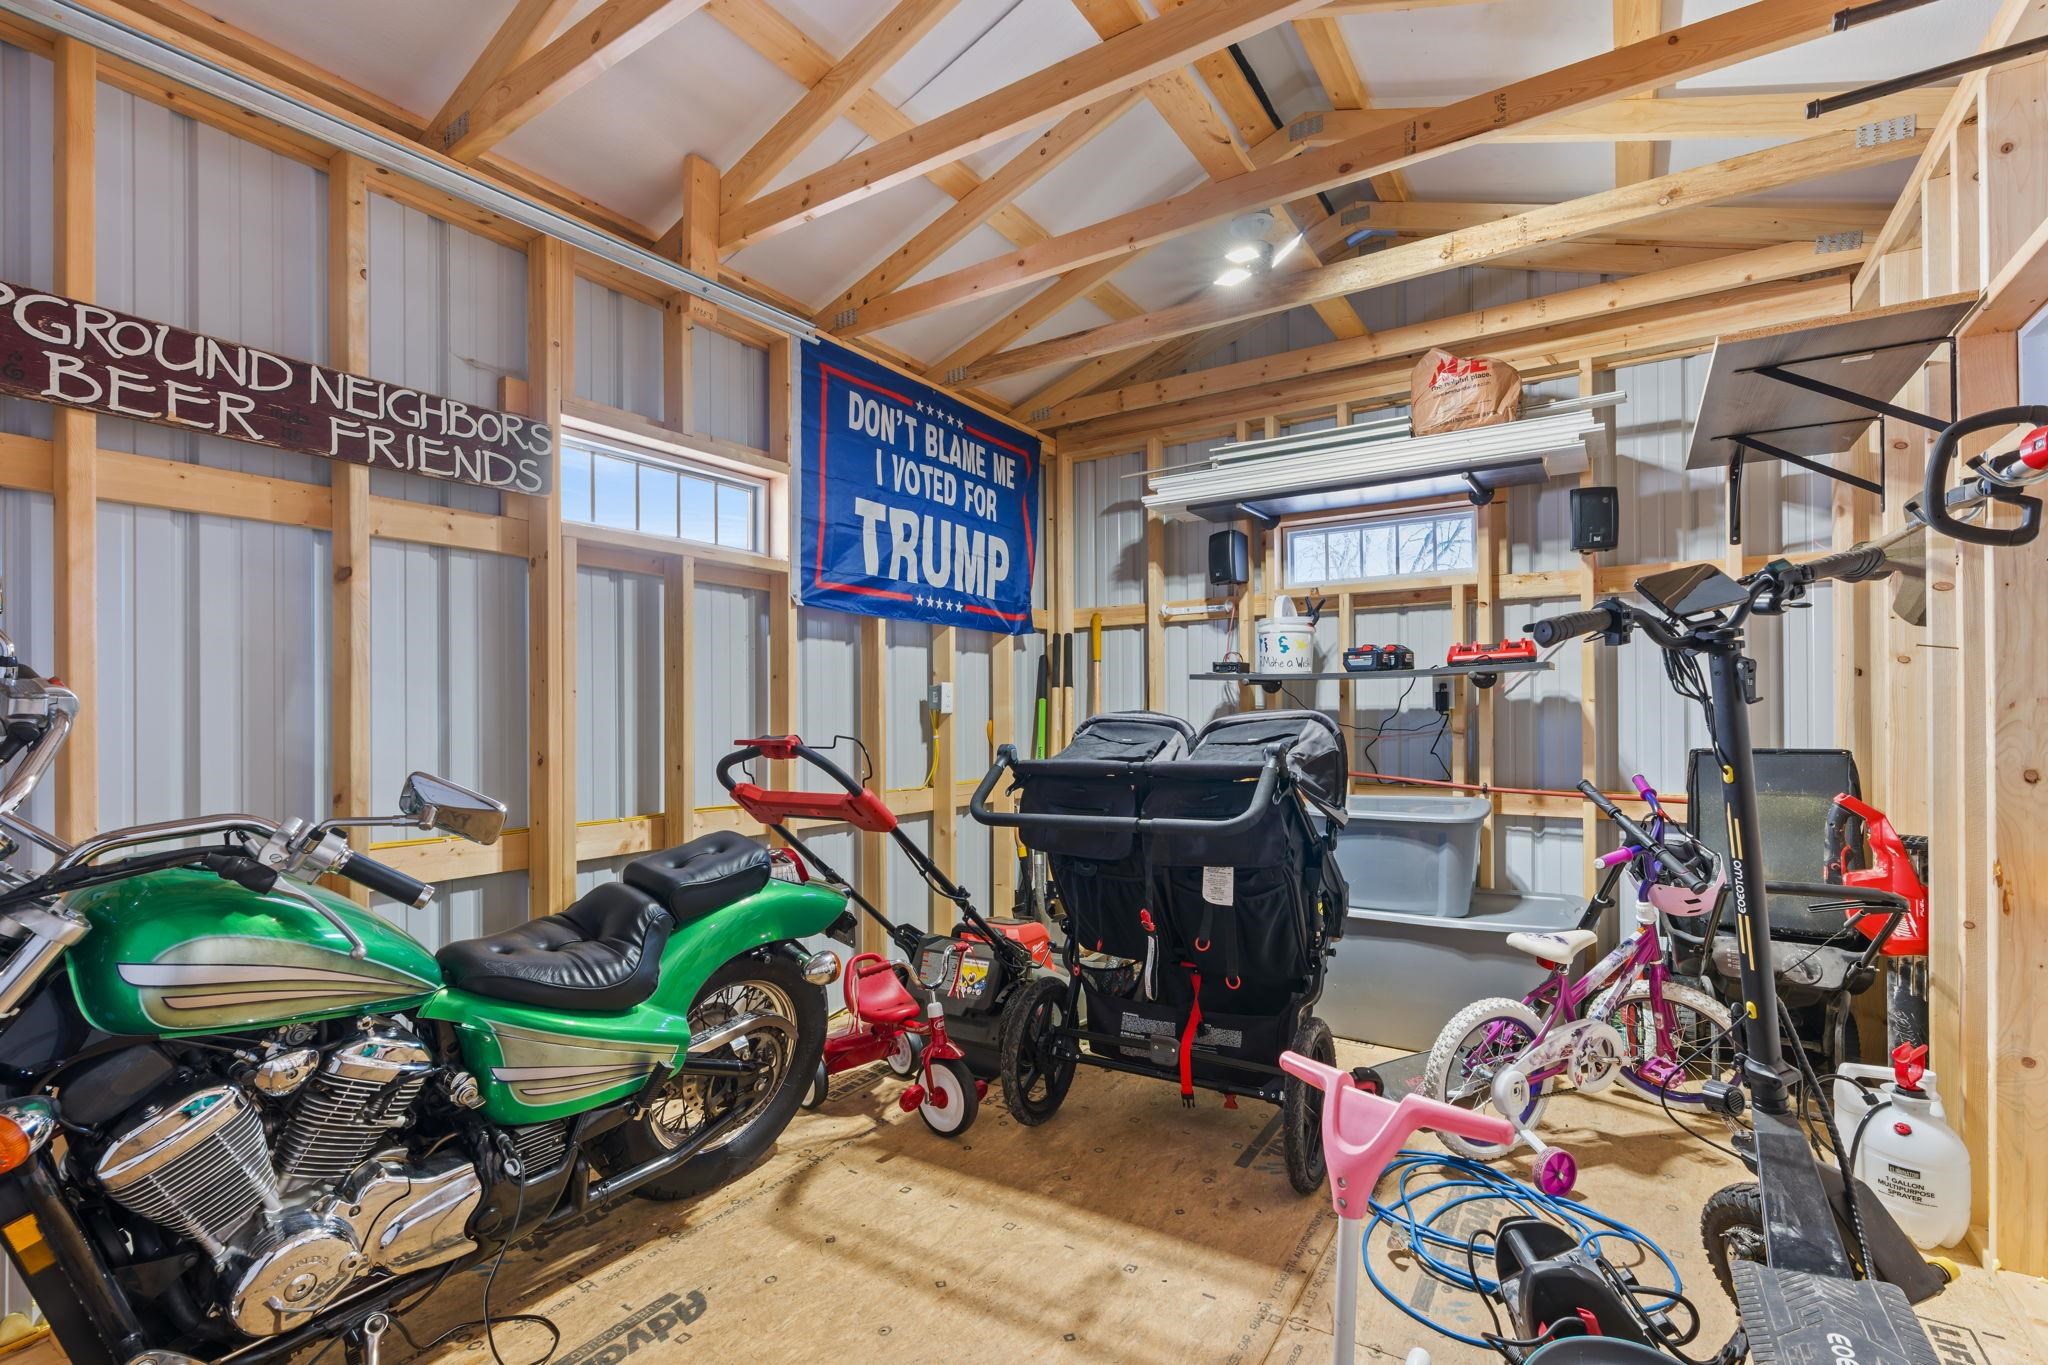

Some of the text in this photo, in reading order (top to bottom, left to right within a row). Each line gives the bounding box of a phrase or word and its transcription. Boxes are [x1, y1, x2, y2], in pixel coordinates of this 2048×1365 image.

[1471, 371, 1492, 381] place.
[40, 350, 264, 441] BEER
[328, 416, 542, 493] FRIENDS
[310, 365, 553, 455] NEIGHBORS
[848, 390, 1016, 490] DON'T BLAME ME
[876, 448, 997, 522] I VOTED FOR
[854, 496, 1010, 600] TRUMP
[1732, 860, 1747, 914] EOEOTWO
[1878, 1178, 1936, 1199] MULTIPURPOSE
[1888, 1188, 1922, 1202] SPRAYER
[1891, 1177, 1925, 1191] GALLON
